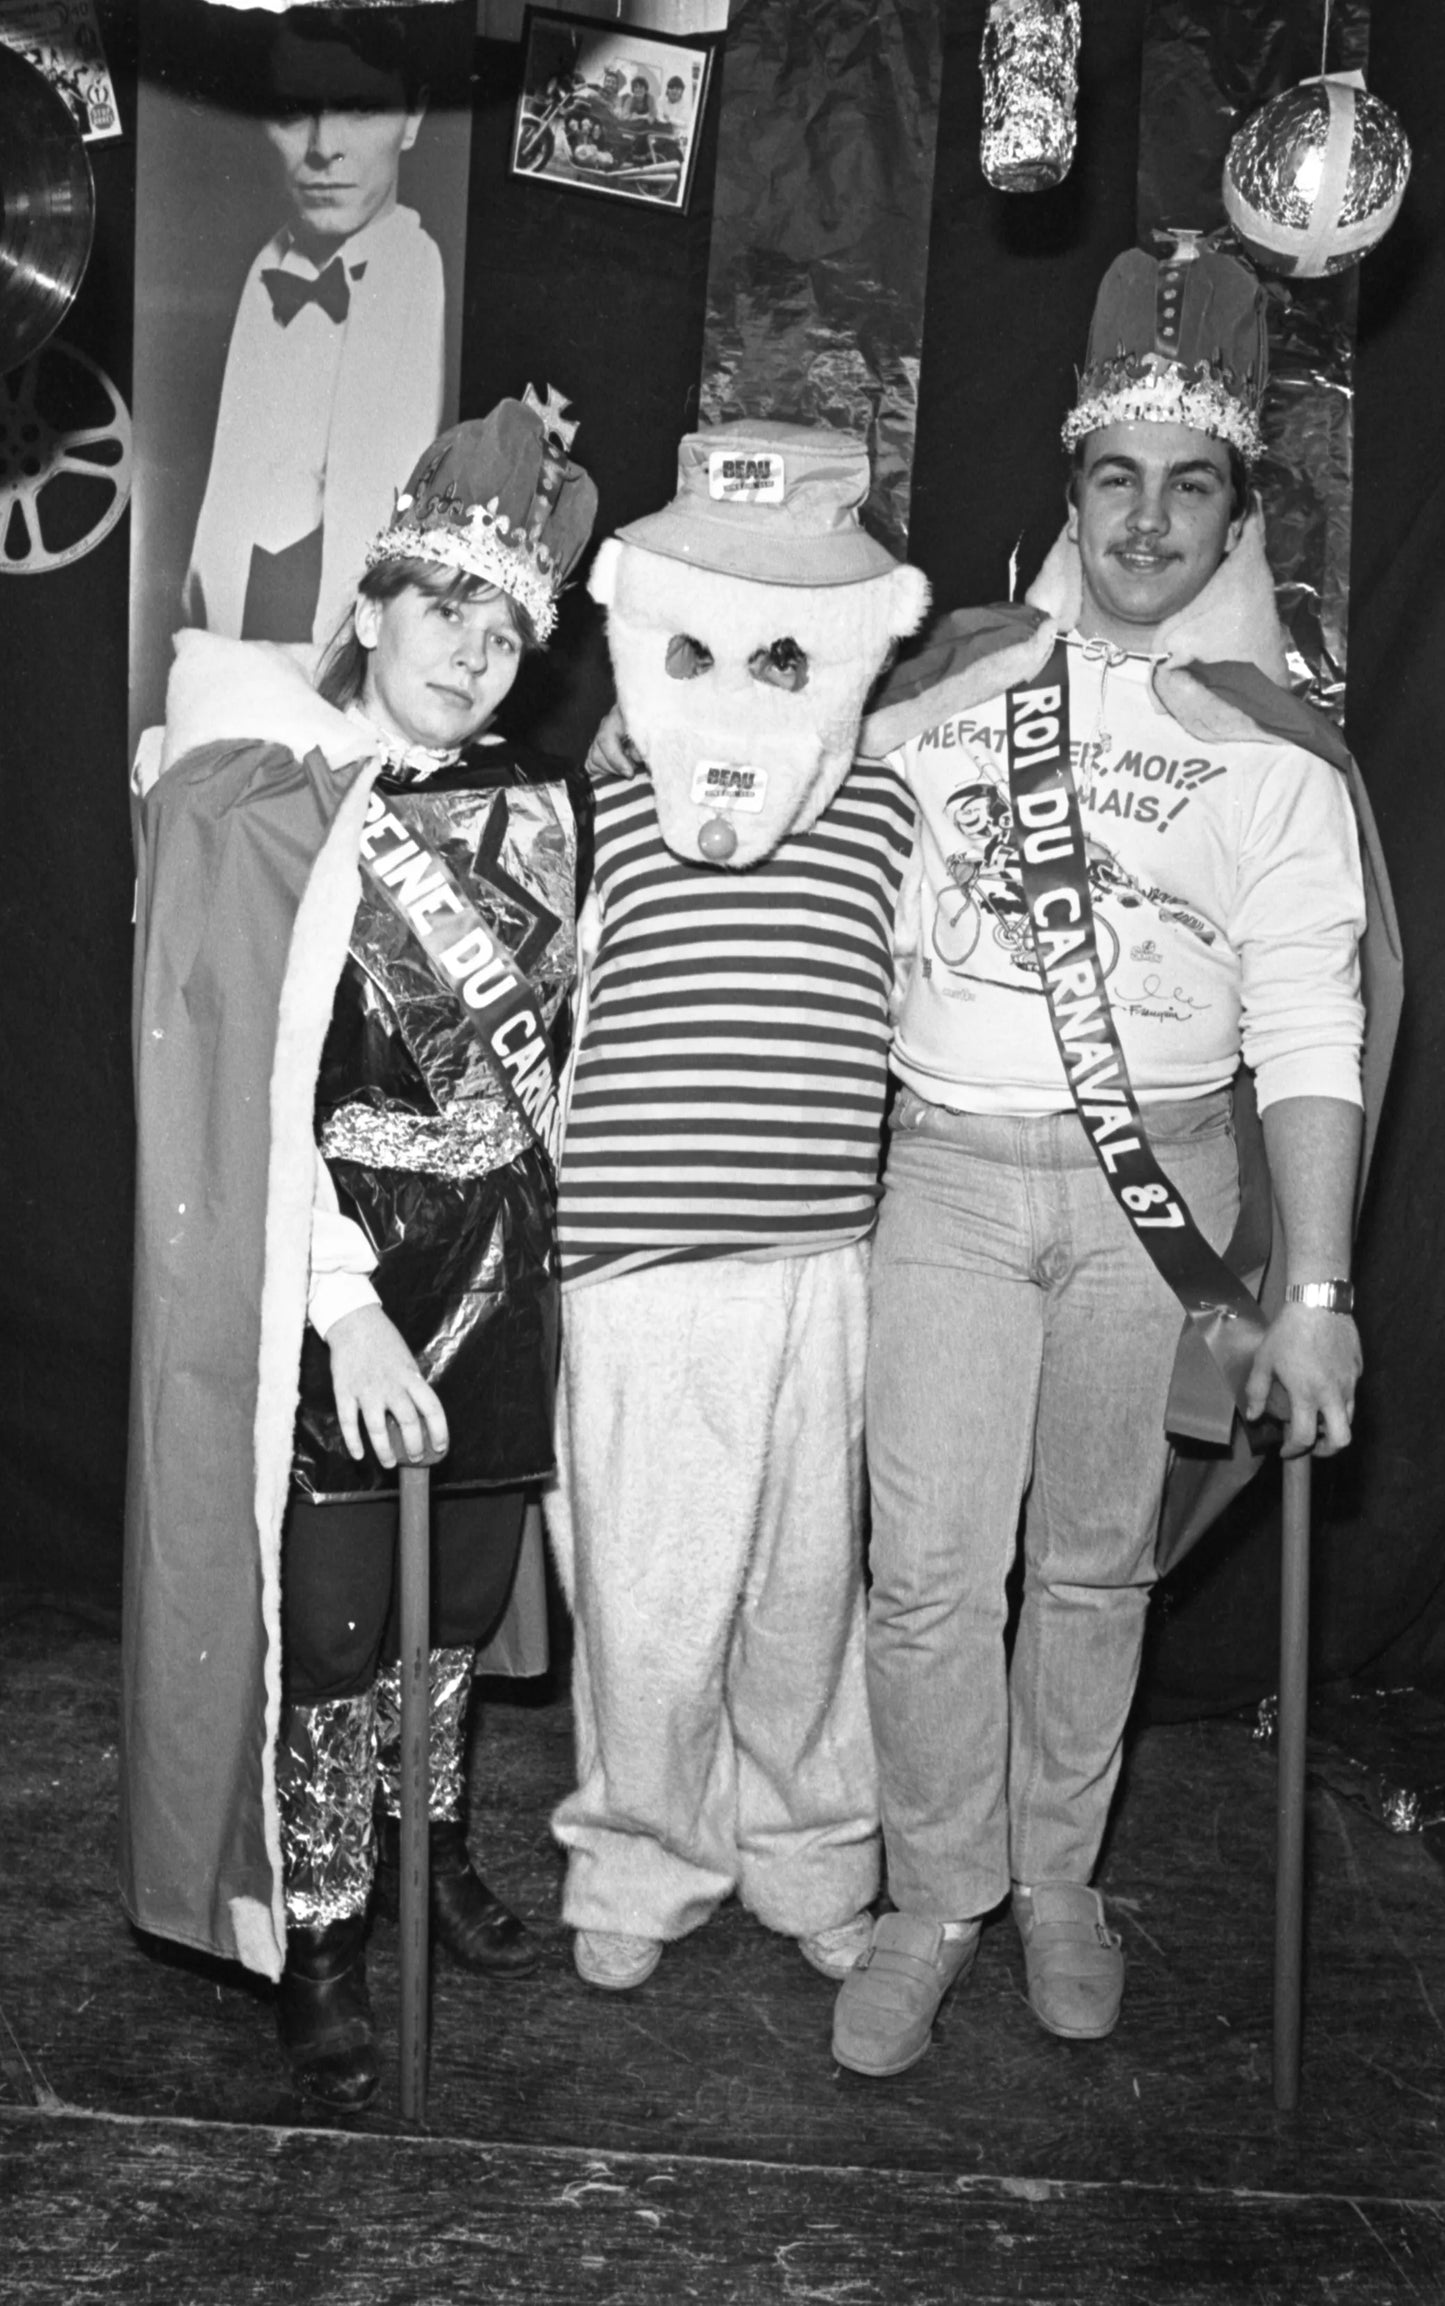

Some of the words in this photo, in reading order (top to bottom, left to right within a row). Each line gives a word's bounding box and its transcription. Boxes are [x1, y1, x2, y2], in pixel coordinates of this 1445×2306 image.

[1013, 685, 1061, 769] ROI
[1017, 788, 1074, 864] DU
[440, 927, 517, 1009] DU
[1033, 887, 1141, 1173] CARNAVAL
[1121, 1184, 1185, 1227] 87
